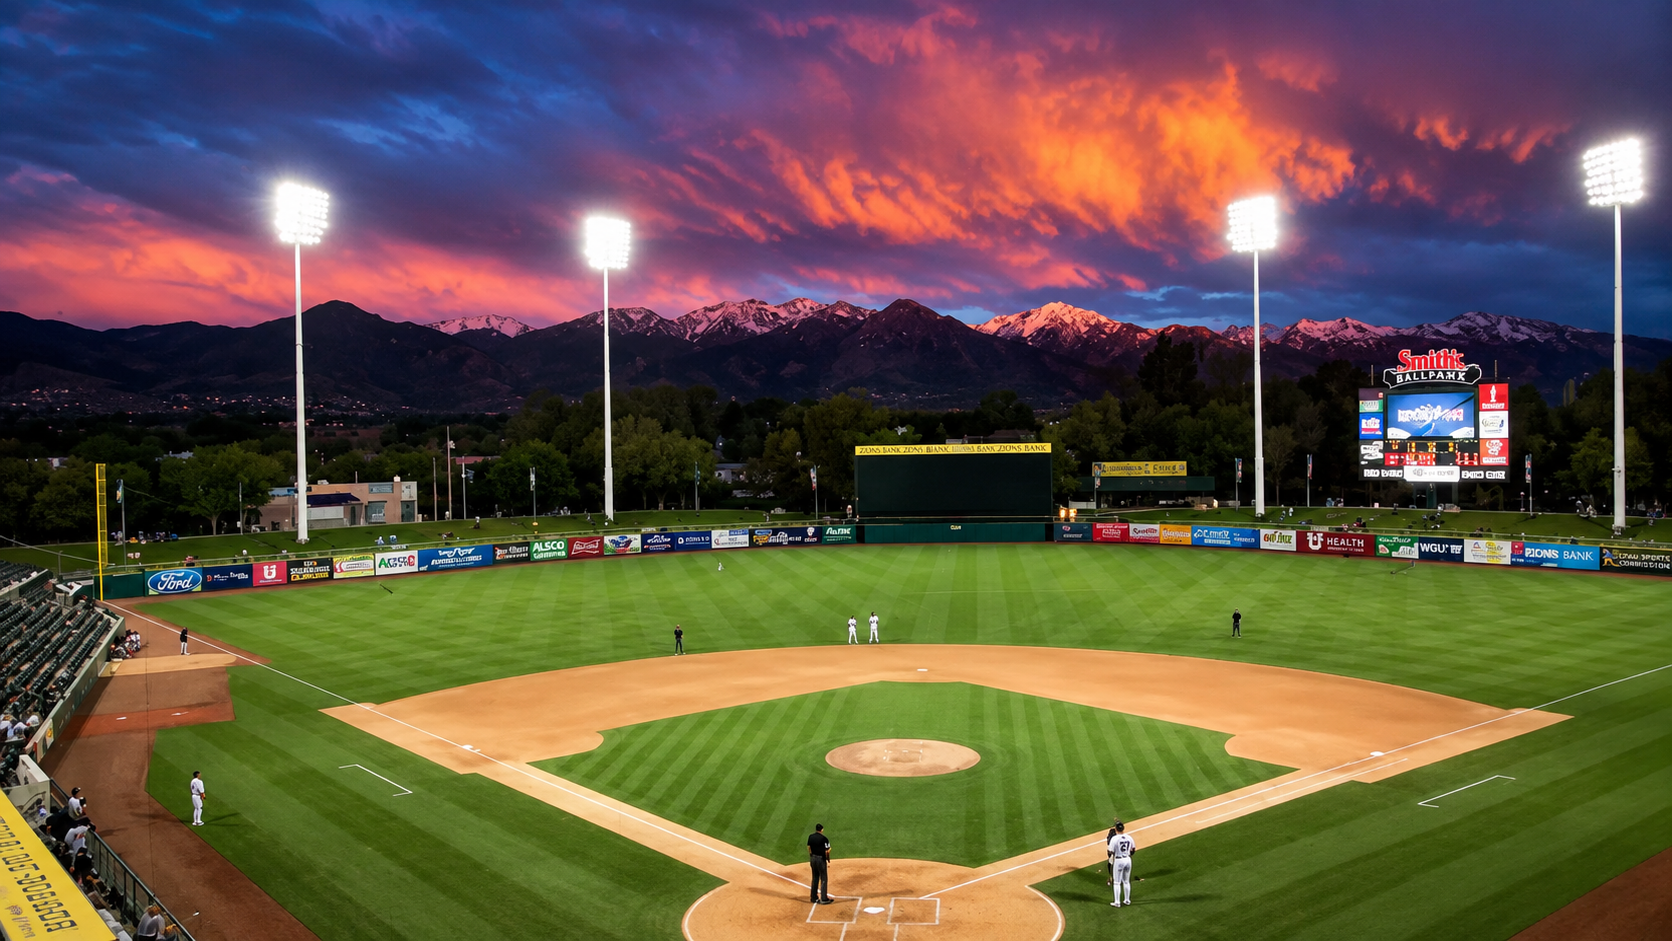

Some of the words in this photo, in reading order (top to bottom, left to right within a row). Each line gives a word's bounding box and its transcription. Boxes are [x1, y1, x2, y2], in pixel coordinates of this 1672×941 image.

[1396, 348, 1466, 373] Smith's
[533, 540, 565, 552] ALSCO
[1327, 537, 1364, 547] HEALTH
[1563, 550, 1594, 561] BANK
[157, 572, 193, 591] Ford
